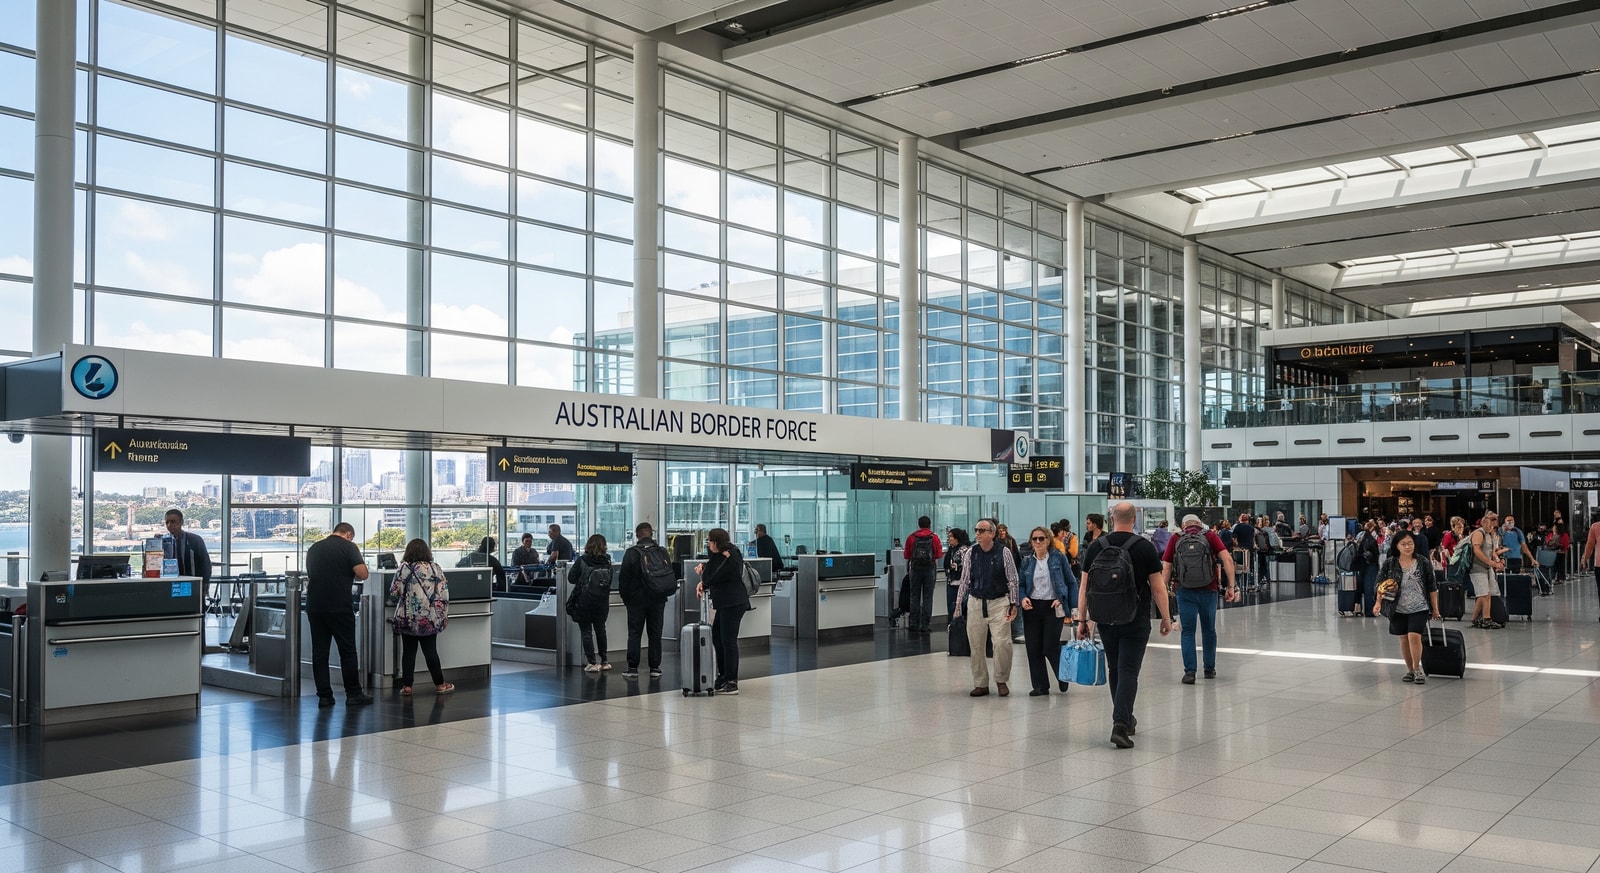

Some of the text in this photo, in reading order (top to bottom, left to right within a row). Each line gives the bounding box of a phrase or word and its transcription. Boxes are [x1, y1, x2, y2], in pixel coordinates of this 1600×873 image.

[555, 402, 817, 442] AUSTRALIAN BORDER FORCE
